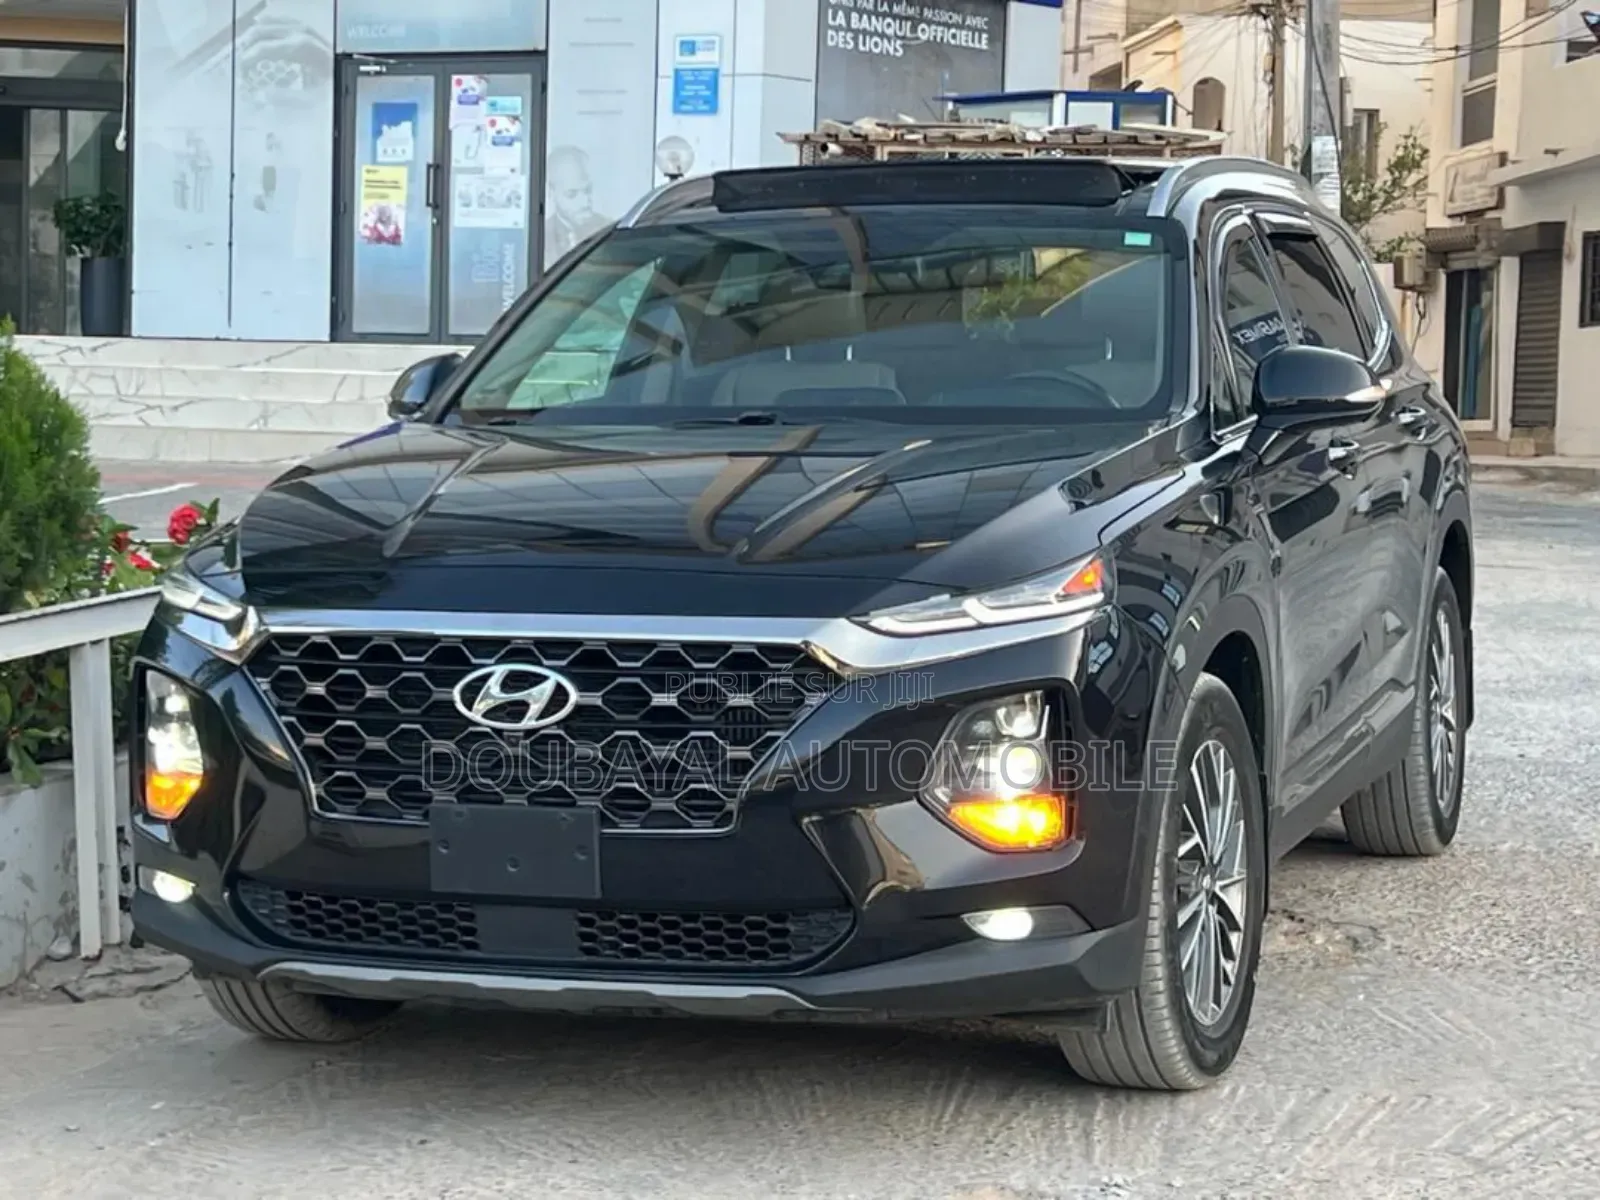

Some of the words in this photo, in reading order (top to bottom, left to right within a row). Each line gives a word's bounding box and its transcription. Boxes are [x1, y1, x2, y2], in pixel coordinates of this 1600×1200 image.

[827, 8, 846, 28] LA
[917, 23, 989, 50] OFFICIELLE
[877, 0, 890, 12] LA
[923, 7, 962, 25] PASSION
[965, 14, 989, 30] AVEC
[827, 29, 855, 50] DES
[858, 33, 904, 57] LIONS
